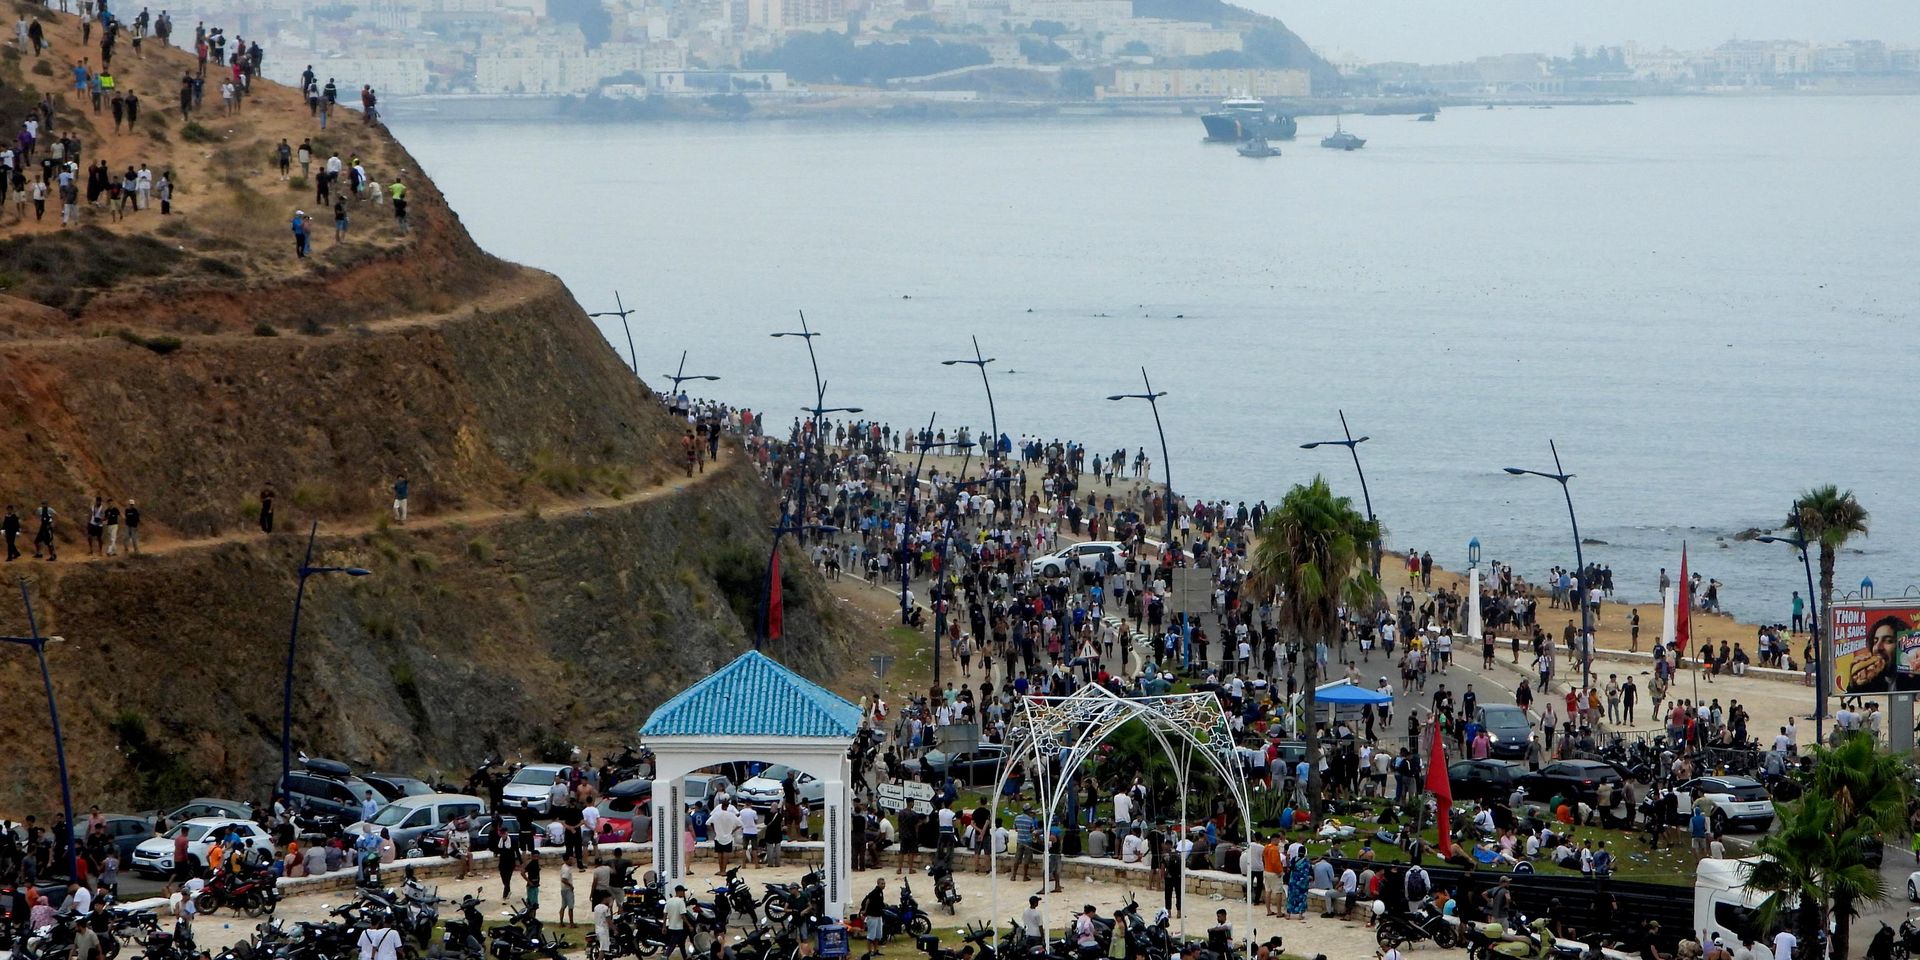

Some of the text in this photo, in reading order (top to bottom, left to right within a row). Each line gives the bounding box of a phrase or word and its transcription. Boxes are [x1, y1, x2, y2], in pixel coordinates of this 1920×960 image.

[1835, 610, 1859, 624] THON
[1835, 626, 1866, 639] LA SAUCE
[695, 815, 703, 826] 8
